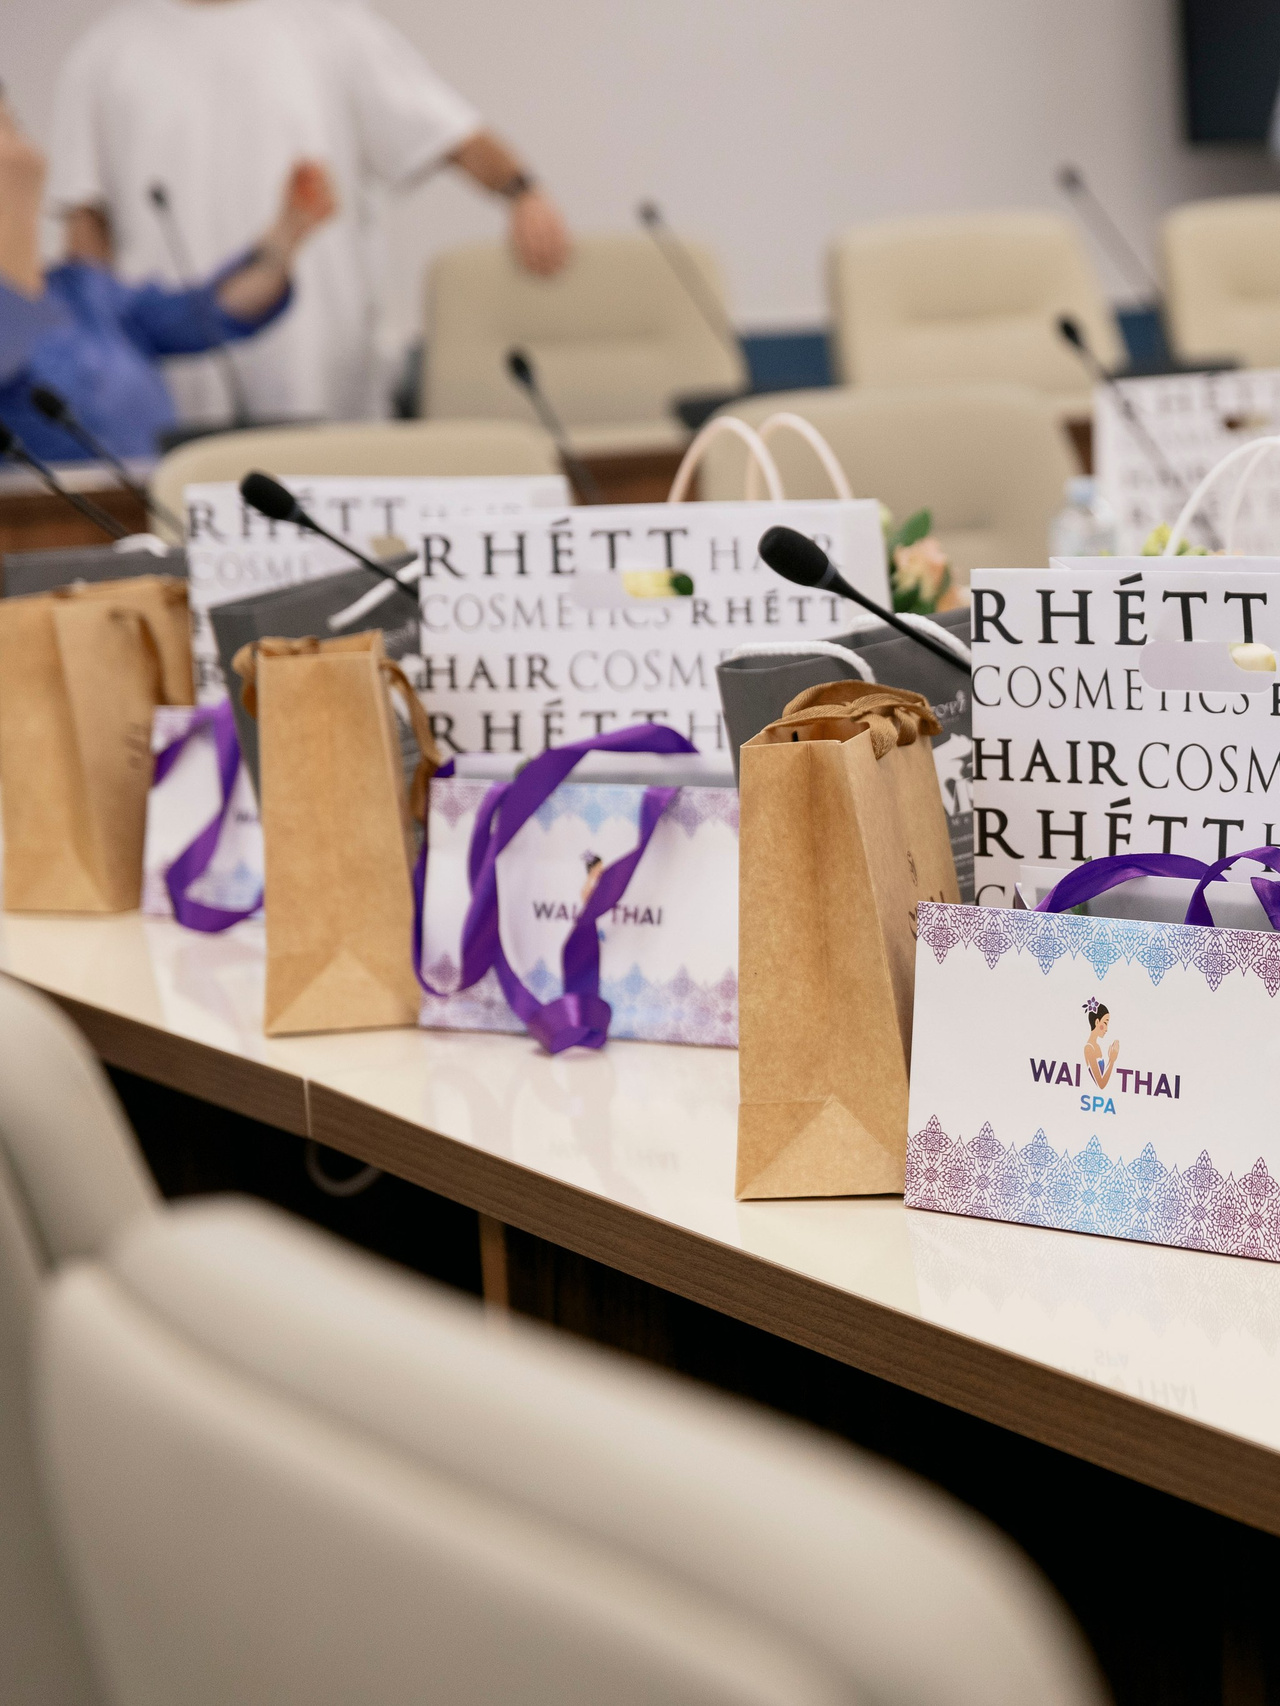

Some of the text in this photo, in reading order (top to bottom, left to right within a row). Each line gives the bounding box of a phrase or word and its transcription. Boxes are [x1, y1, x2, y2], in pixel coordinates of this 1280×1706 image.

[422, 518, 689, 578] RHÉTT
[691, 589, 843, 629] RHÉTT
[971, 573, 1268, 645] RHÉTT
[424, 655, 559, 692] HAIR
[972, 738, 1128, 786] HAIR
[973, 796, 1245, 872] RHÉTT
[1029, 1057, 1181, 1100] WAI THAI
[1080, 1093, 1117, 1115] SPA
